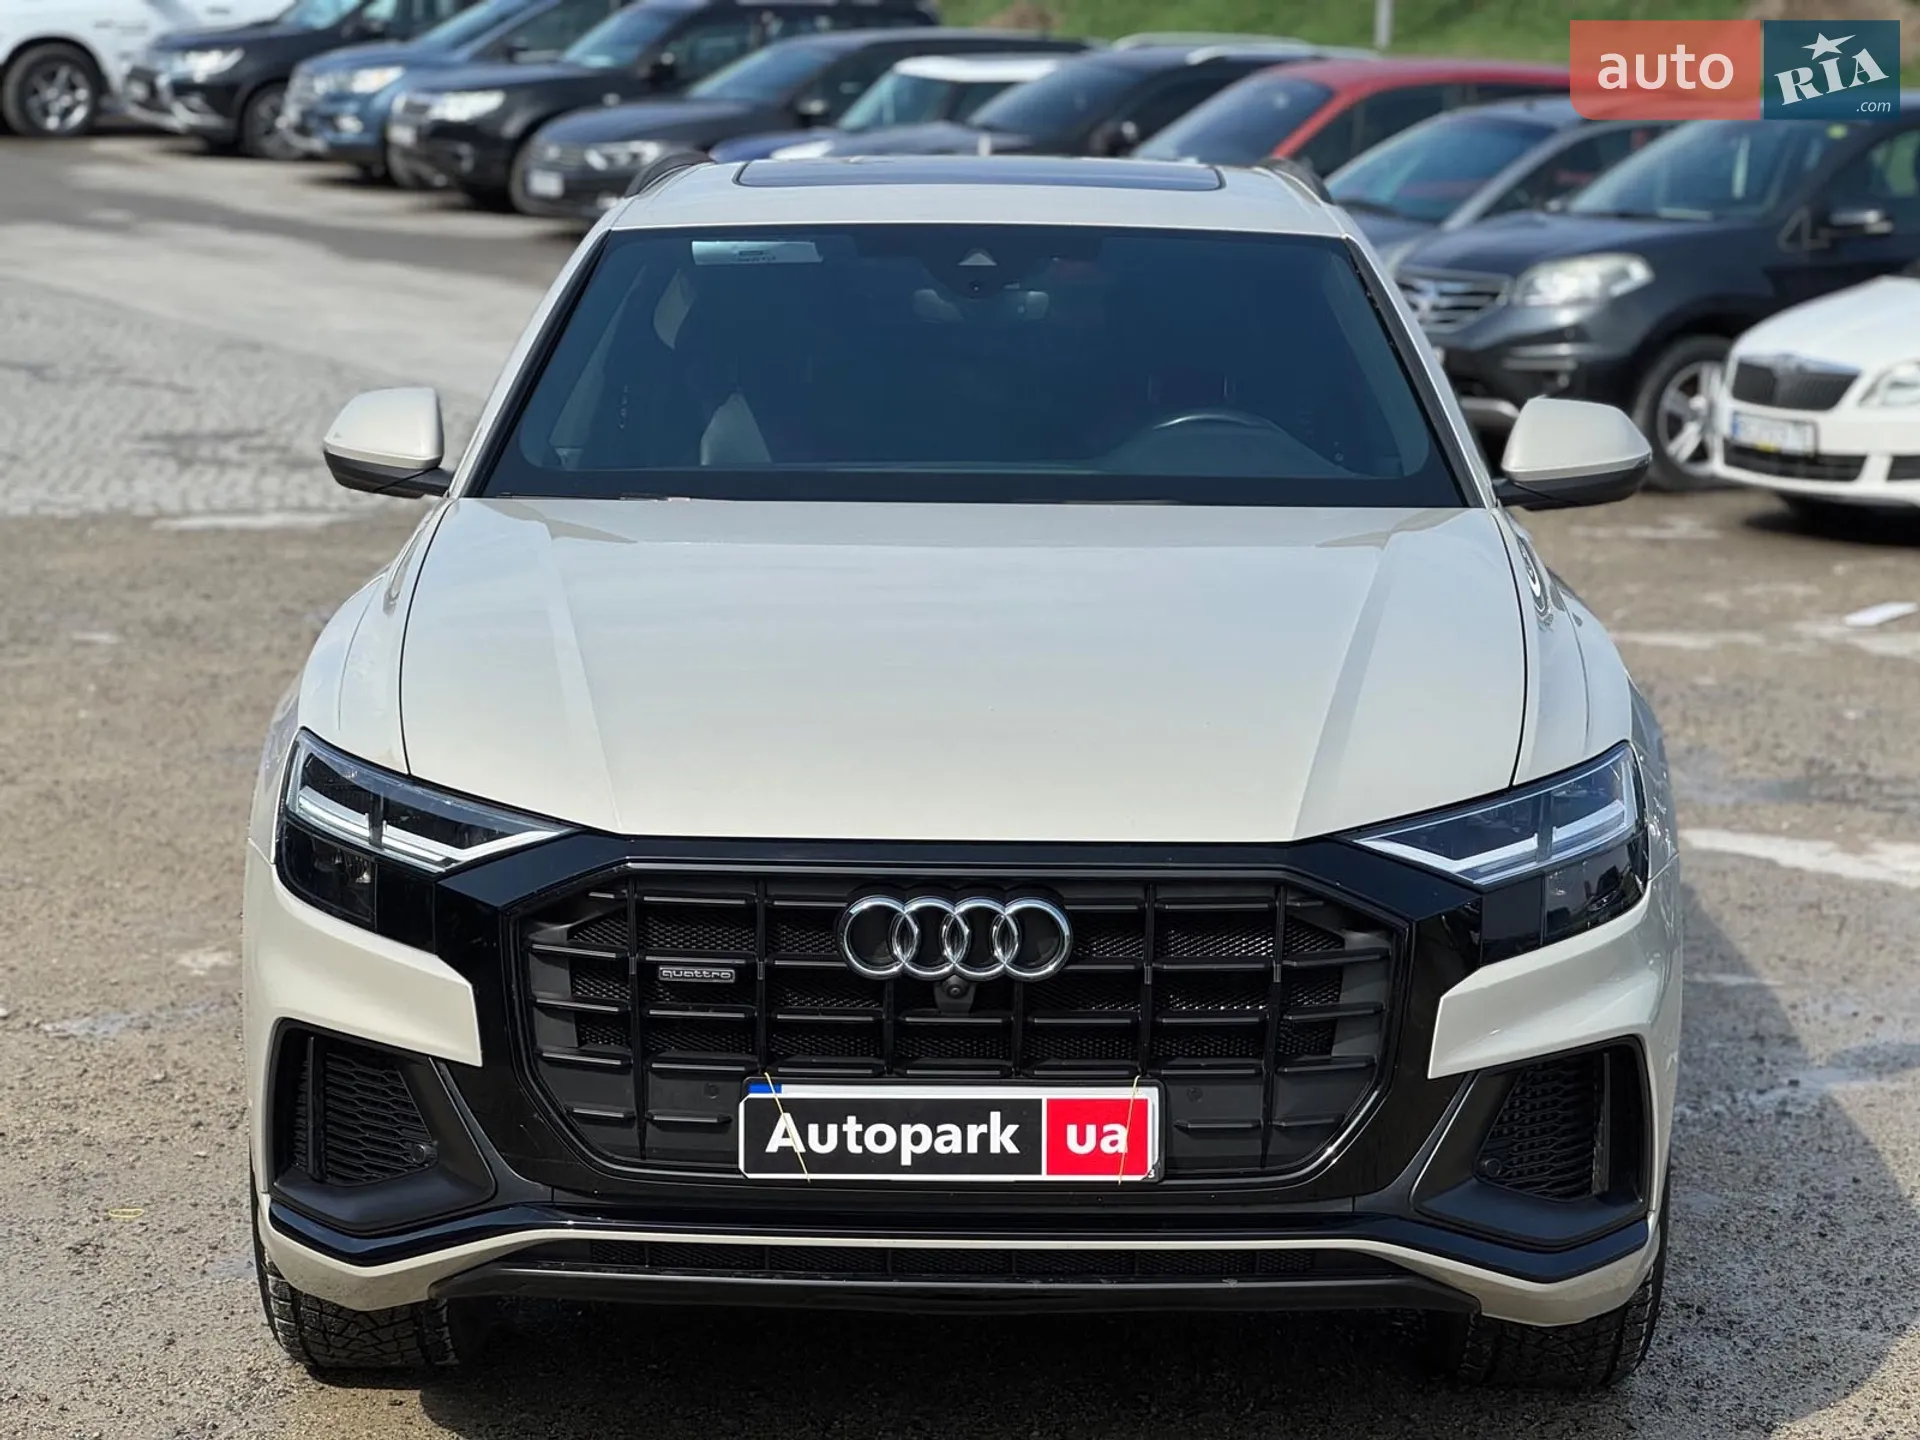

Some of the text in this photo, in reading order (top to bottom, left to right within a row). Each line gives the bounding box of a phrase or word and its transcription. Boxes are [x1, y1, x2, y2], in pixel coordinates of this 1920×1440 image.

[662, 969, 732, 979] quattro
[765, 1110, 1129, 1167] Autopark ua
